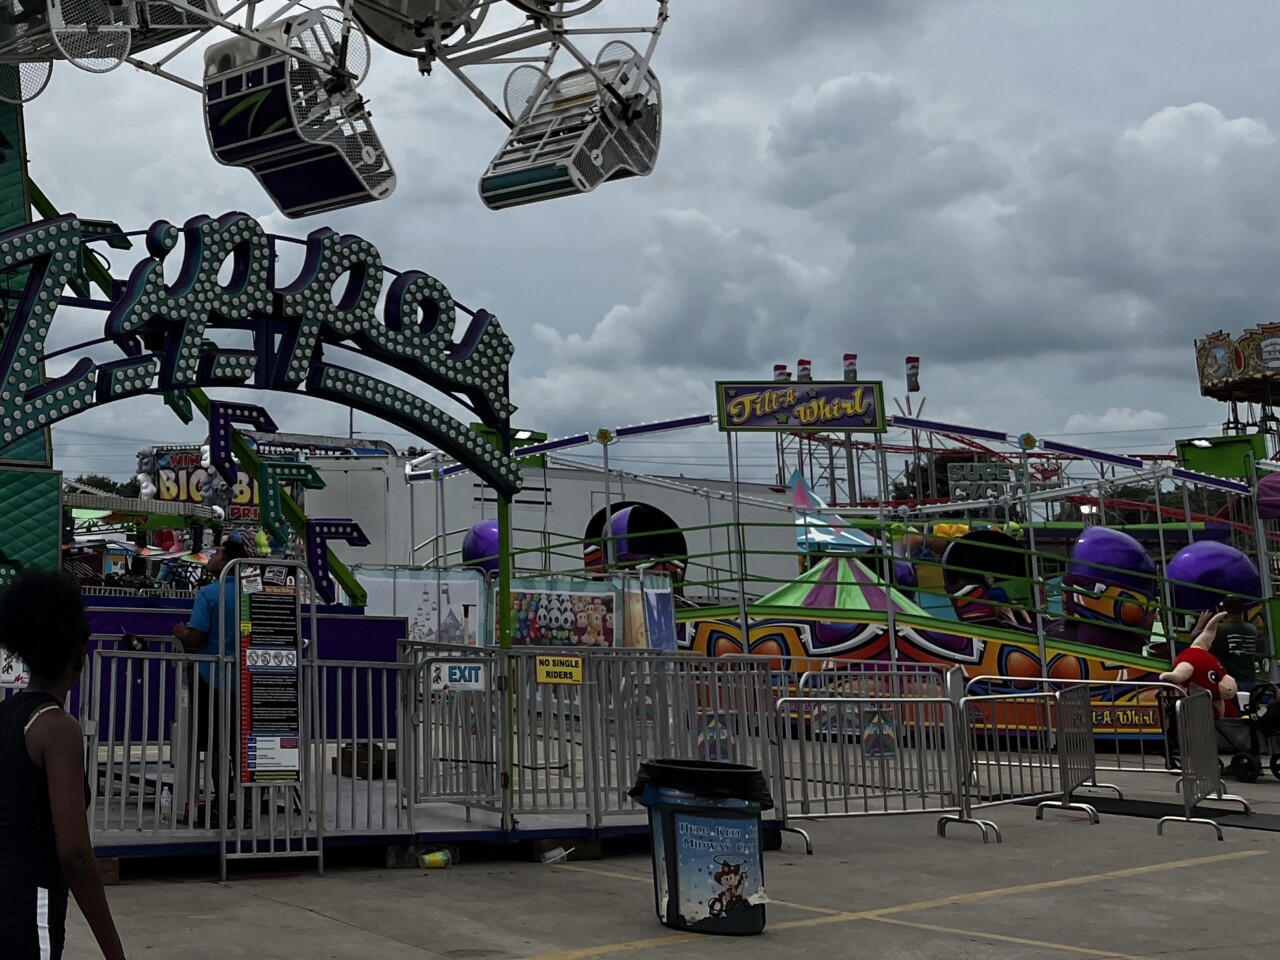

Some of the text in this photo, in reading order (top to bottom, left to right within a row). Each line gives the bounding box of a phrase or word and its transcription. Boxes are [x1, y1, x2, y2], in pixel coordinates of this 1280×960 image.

[793, 388, 870, 426] Whirl
[169, 453, 202, 467] WIN
[538, 659, 580, 668] NO SINGLE
[448, 665, 481, 683] EXIT
[545, 671, 574, 680] RIDERS
[1115, 705, 1155, 725] Whirl
[680, 822, 710, 836] HELP
[682, 837, 733, 852] MIDWAY
